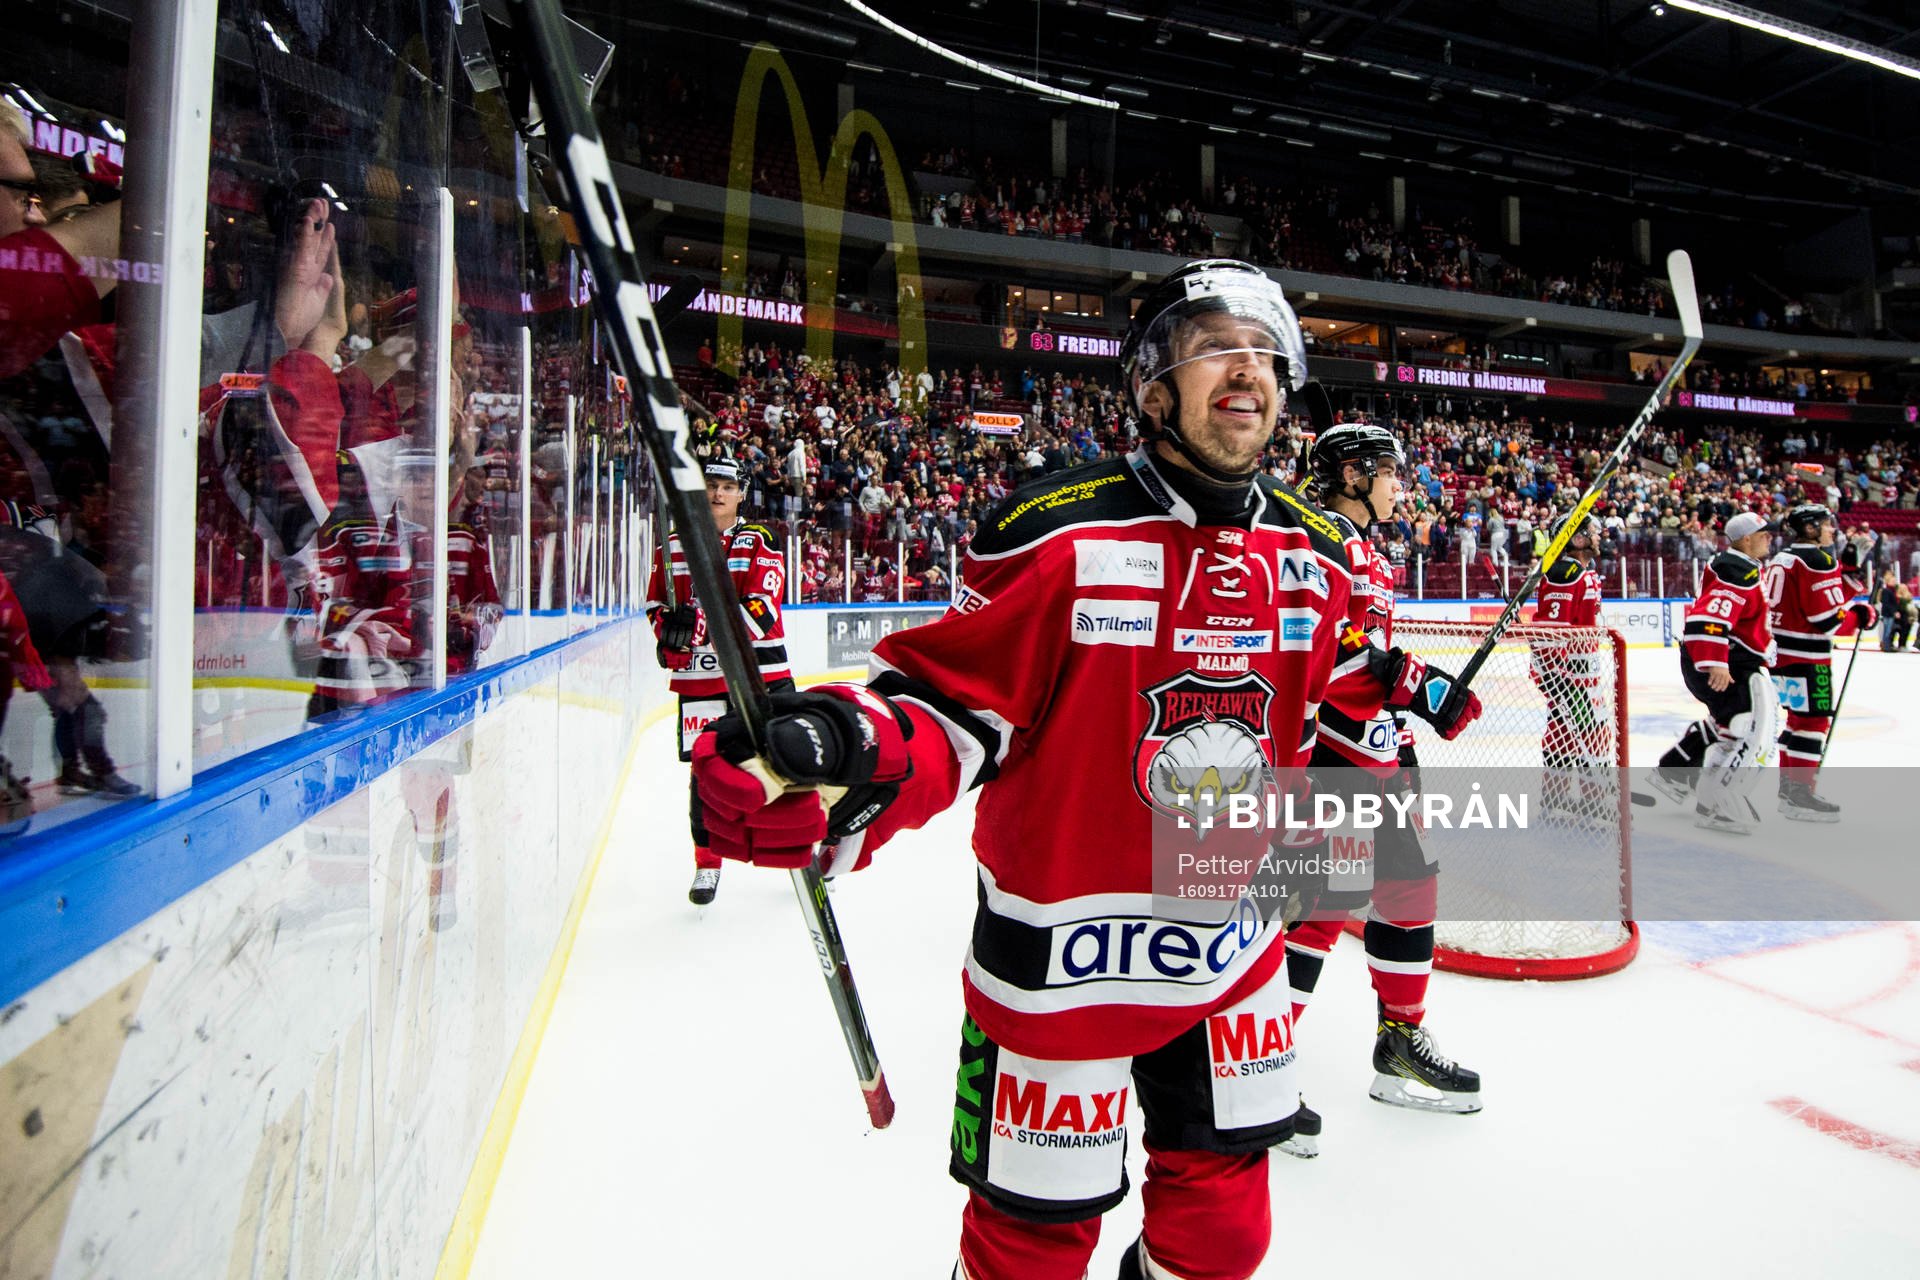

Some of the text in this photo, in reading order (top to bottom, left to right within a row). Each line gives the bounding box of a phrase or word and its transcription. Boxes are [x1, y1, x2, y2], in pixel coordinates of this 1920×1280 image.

[1030, 332, 1053, 351] 63
[1397, 366, 1547, 394] 63 FREDRIK HÄNDEMARK
[1694, 393, 1736, 411] FREDRIK
[1737, 397, 1796, 416] HÄNDEMARK
[978, 415, 1018, 426] ROLLS
[1613, 394, 1661, 464] CCM
[1079, 490, 1096, 501] AB
[1215, 531, 1244, 547] SHL
[1823, 586, 1845, 606] 10
[1548, 602, 1561, 619] 3
[1706, 597, 1732, 618] 69
[1205, 615, 1254, 627] CCM
[1196, 635, 1267, 648] INTERSPORT
[1197, 654, 1250, 672] MALMÖ
[1811, 664, 1829, 710] akea
[1162, 690, 1266, 731] REDHAWKS
[1062, 897, 1257, 978] areco
[1214, 1066, 1237, 1078] ICA
[995, 1072, 1128, 1134] MAXI
[993, 1121, 1126, 1150] ICA STORMARKNAD
